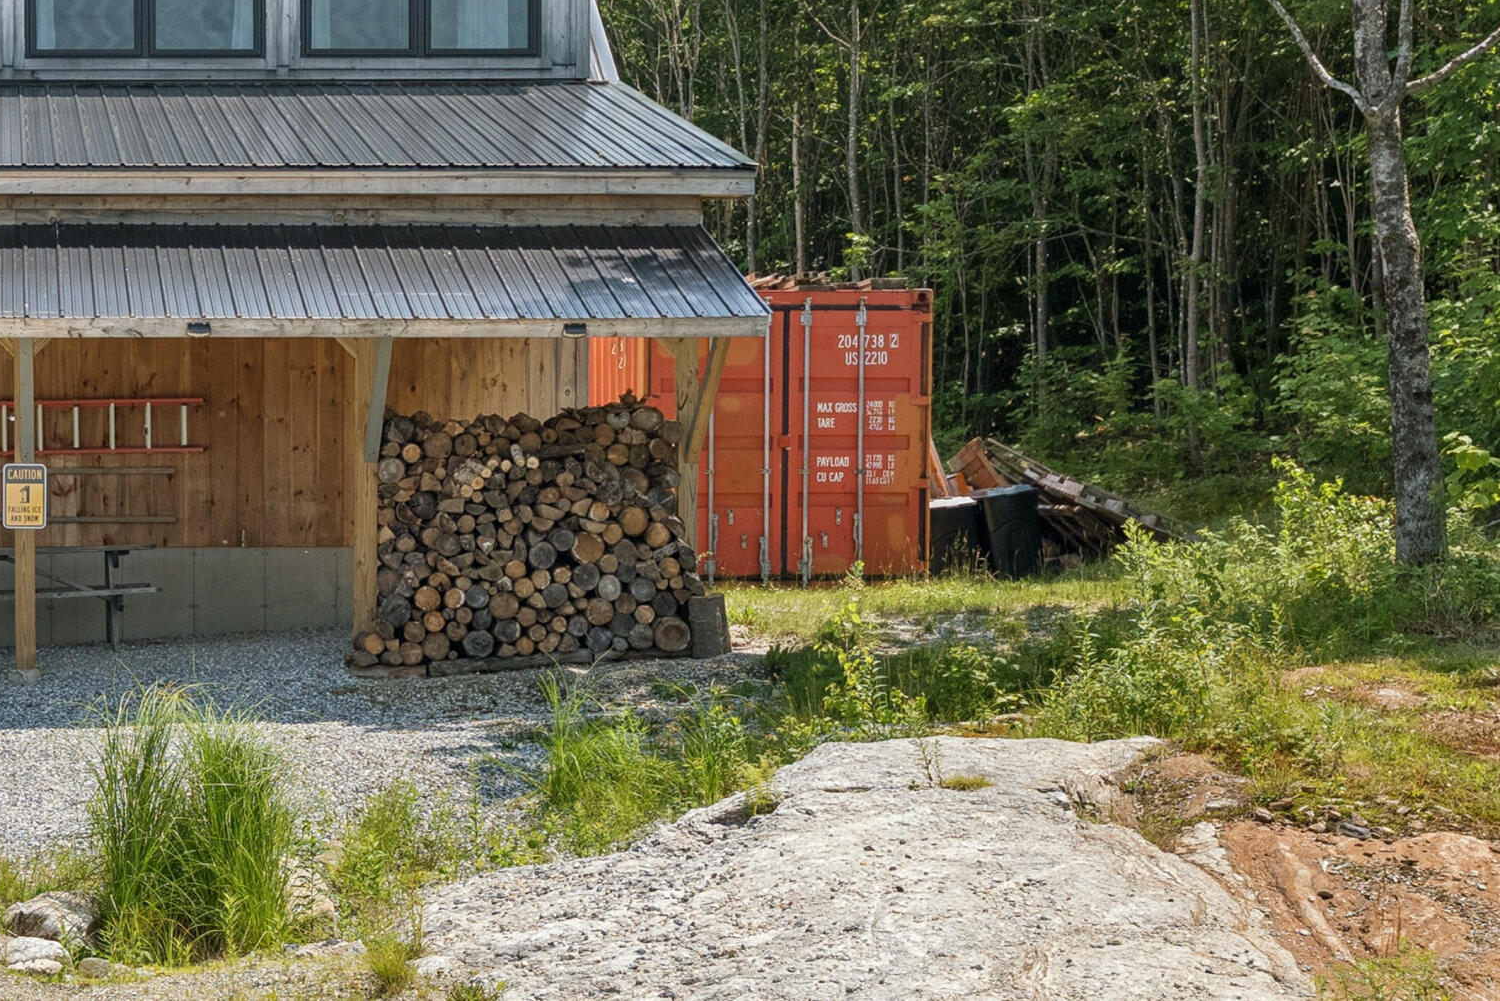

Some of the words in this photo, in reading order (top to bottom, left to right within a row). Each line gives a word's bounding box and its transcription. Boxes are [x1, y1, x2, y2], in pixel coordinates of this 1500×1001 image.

[838, 334, 858, 348] 204
[864, 334, 884, 348] 738
[891, 334, 898, 348] 2
[845, 351, 858, 365] US
[864, 351, 888, 365] 2210
[817, 402, 833, 413] MAX
[835, 402, 857, 413] GROSS
[817, 417, 835, 428] TARE
[816, 456, 849, 467] PAYLOAD
[7, 469, 42, 480] CAUTION
[816, 472, 827, 482] CU
[829, 472, 844, 482] CAP
